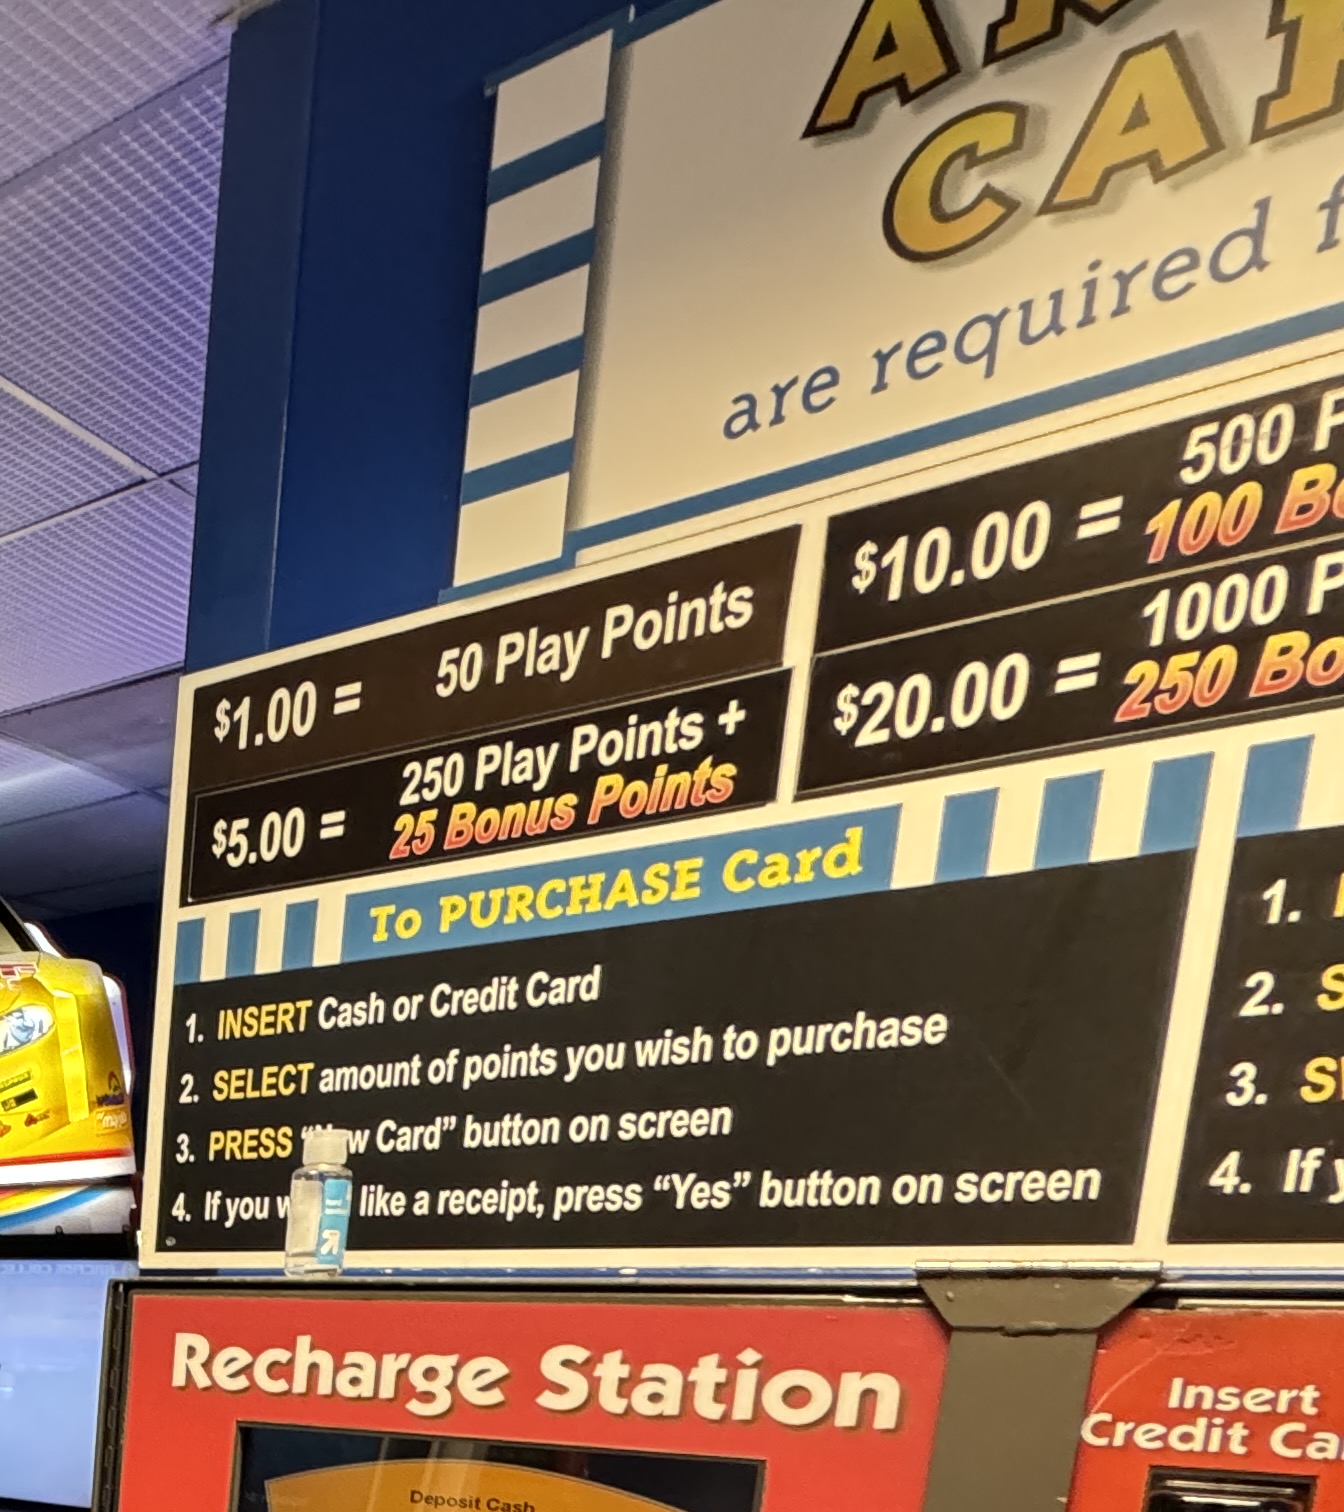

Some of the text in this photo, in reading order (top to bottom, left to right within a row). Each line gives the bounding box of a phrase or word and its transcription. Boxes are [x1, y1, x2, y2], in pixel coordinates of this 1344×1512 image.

[721, 363, 841, 441] are
[869, 195, 1273, 397] required
[1178, 402, 1296, 486] 500
[851, 499, 1052, 603] $10.00
[1145, 481, 1264, 565] 100
[1141, 565, 1290, 648] 1000
[213, 680, 318, 750] $1.00
[435, 641, 484, 698] 50
[495, 623, 589, 686] Play
[600, 581, 756, 660] Points
[832, 652, 1031, 749] $20.00
[1114, 644, 1239, 724] 250
[399, 699, 748, 808] 250 Play Points +
[211, 806, 307, 869] $5.00
[388, 755, 739, 860] 25 Bonus Points
[370, 826, 865, 943] To PURCHASE Card
[1262, 878, 1301, 926] 1.
[185, 964, 603, 1044] 1. INSERT Cash or Credit Card
[1239, 972, 1285, 1017] 2.
[178, 1008, 950, 1105] 2. SELECT amount of points you wish to purchase
[1226, 1061, 1269, 1108] 3.
[175, 1133, 195, 1164] 3.
[208, 1127, 294, 1162] PRESS
[376, 1113, 457, 1155] Card”
[463, 1112, 560, 1150] button
[568, 1113, 609, 1145] on
[617, 1105, 733, 1141] screen
[1210, 1151, 1252, 1197] 4.
[1283, 1146, 1325, 1196] If
[171, 1192, 193, 1223] 4.
[204, 1189, 223, 1223] If
[225, 1195, 266, 1228] you
[359, 1185, 407, 1218] like
[413, 1194, 431, 1216] a
[436, 1180, 545, 1222] receipt,
[553, 1180, 643, 1219] press
[654, 1171, 751, 1211] “Yes”
[758, 1168, 880, 1210] button
[891, 1173, 943, 1205] on
[954, 1162, 1103, 1204] screen
[171, 1331, 904, 1433] Recharge Station
[1167, 1376, 1321, 1416] Insert
[1080, 1412, 1344, 1461] Credit Ca
